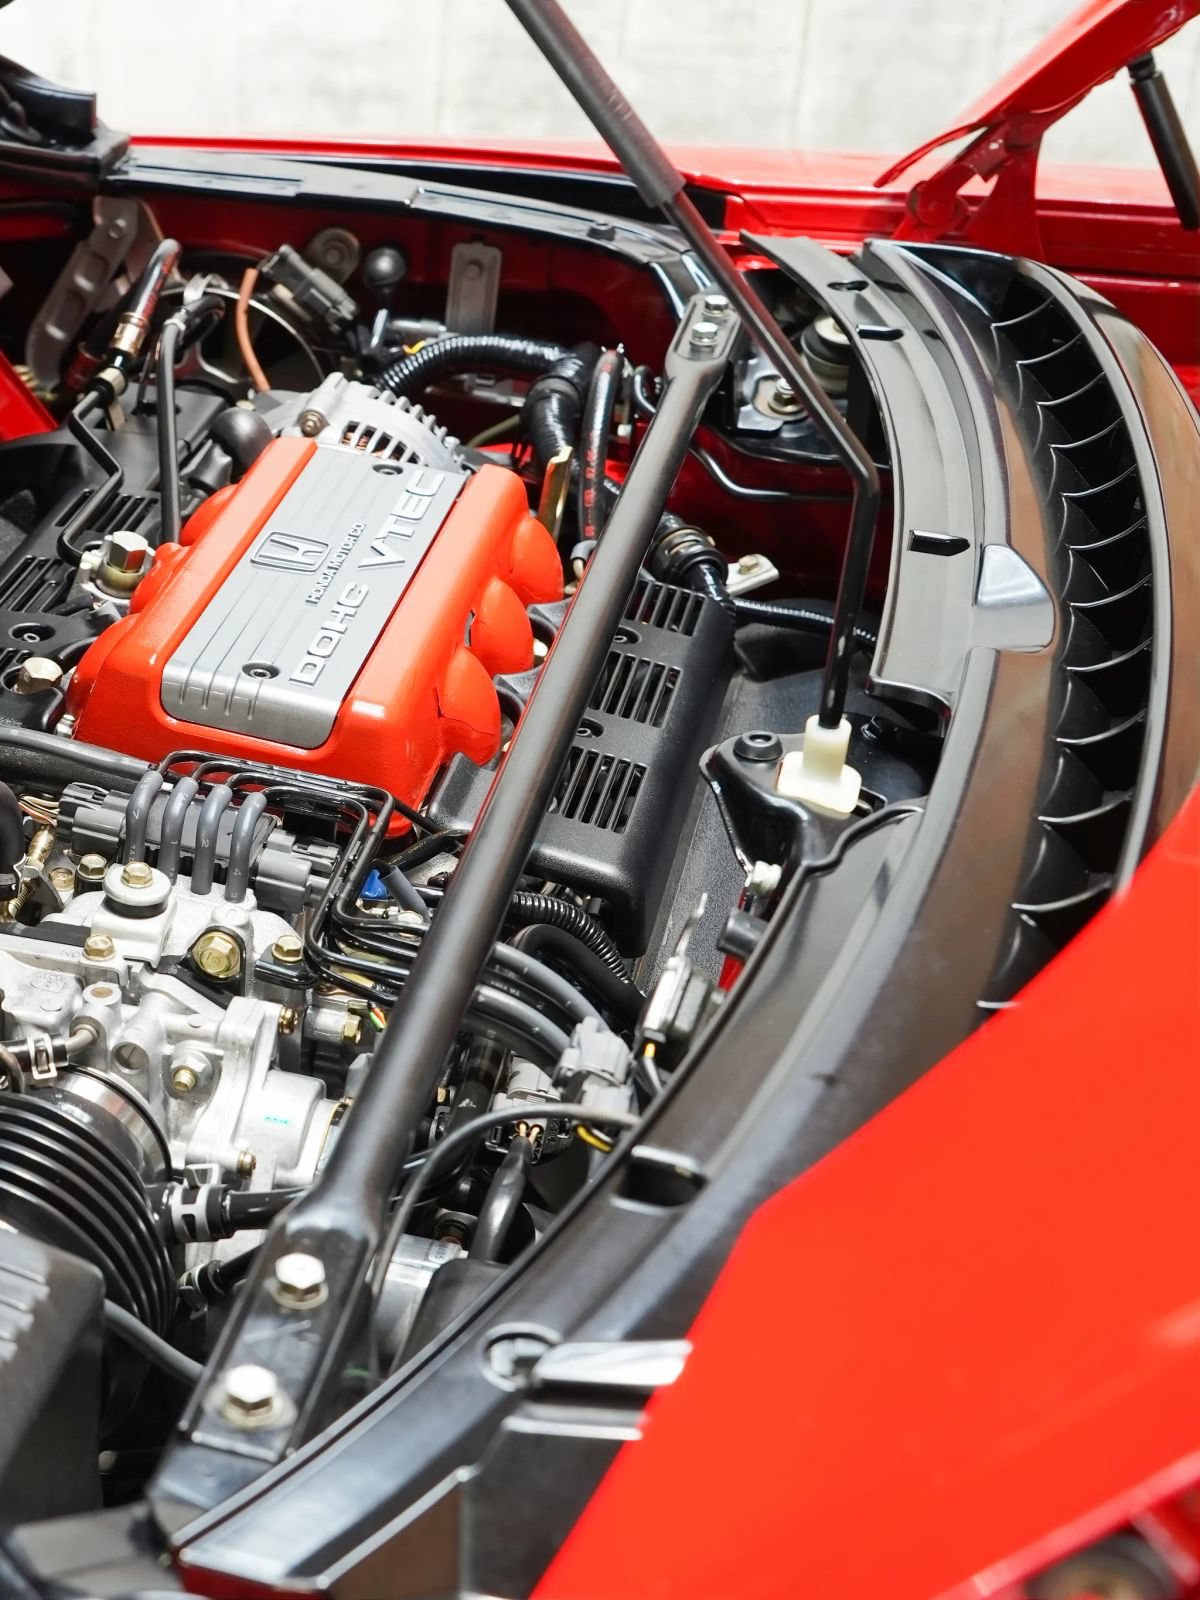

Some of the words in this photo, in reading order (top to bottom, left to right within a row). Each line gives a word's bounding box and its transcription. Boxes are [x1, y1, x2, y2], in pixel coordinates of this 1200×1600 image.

[289, 582, 369, 688] DOHC
[358, 469, 447, 572] VTEC
[305, 568, 336, 605] HONDA
[327, 534, 358, 571] MOTOR
